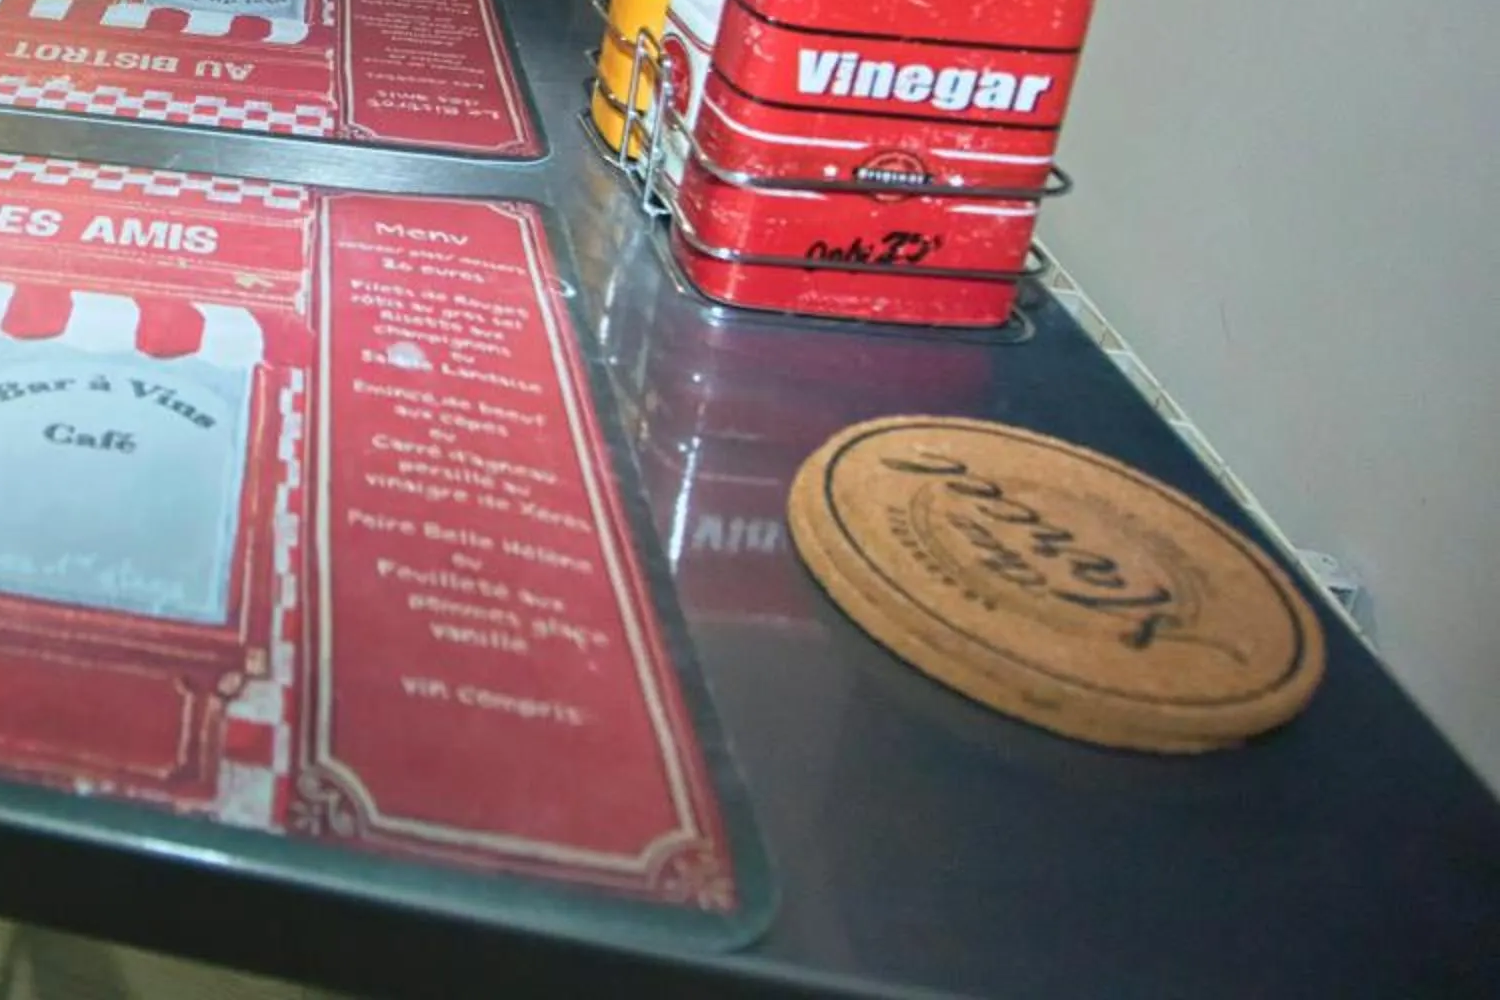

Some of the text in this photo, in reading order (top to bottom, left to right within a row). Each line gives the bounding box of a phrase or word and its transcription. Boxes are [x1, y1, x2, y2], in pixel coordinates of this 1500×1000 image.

[4, 40, 178, 74] BISTROT
[194, 61, 257, 82] AU
[797, 48, 1053, 114] Vinegar
[79, 220, 220, 256] AMIS
[87, 374, 112, 393] à
[127, 377, 218, 430] Vins
[41, 423, 138, 454] Café
